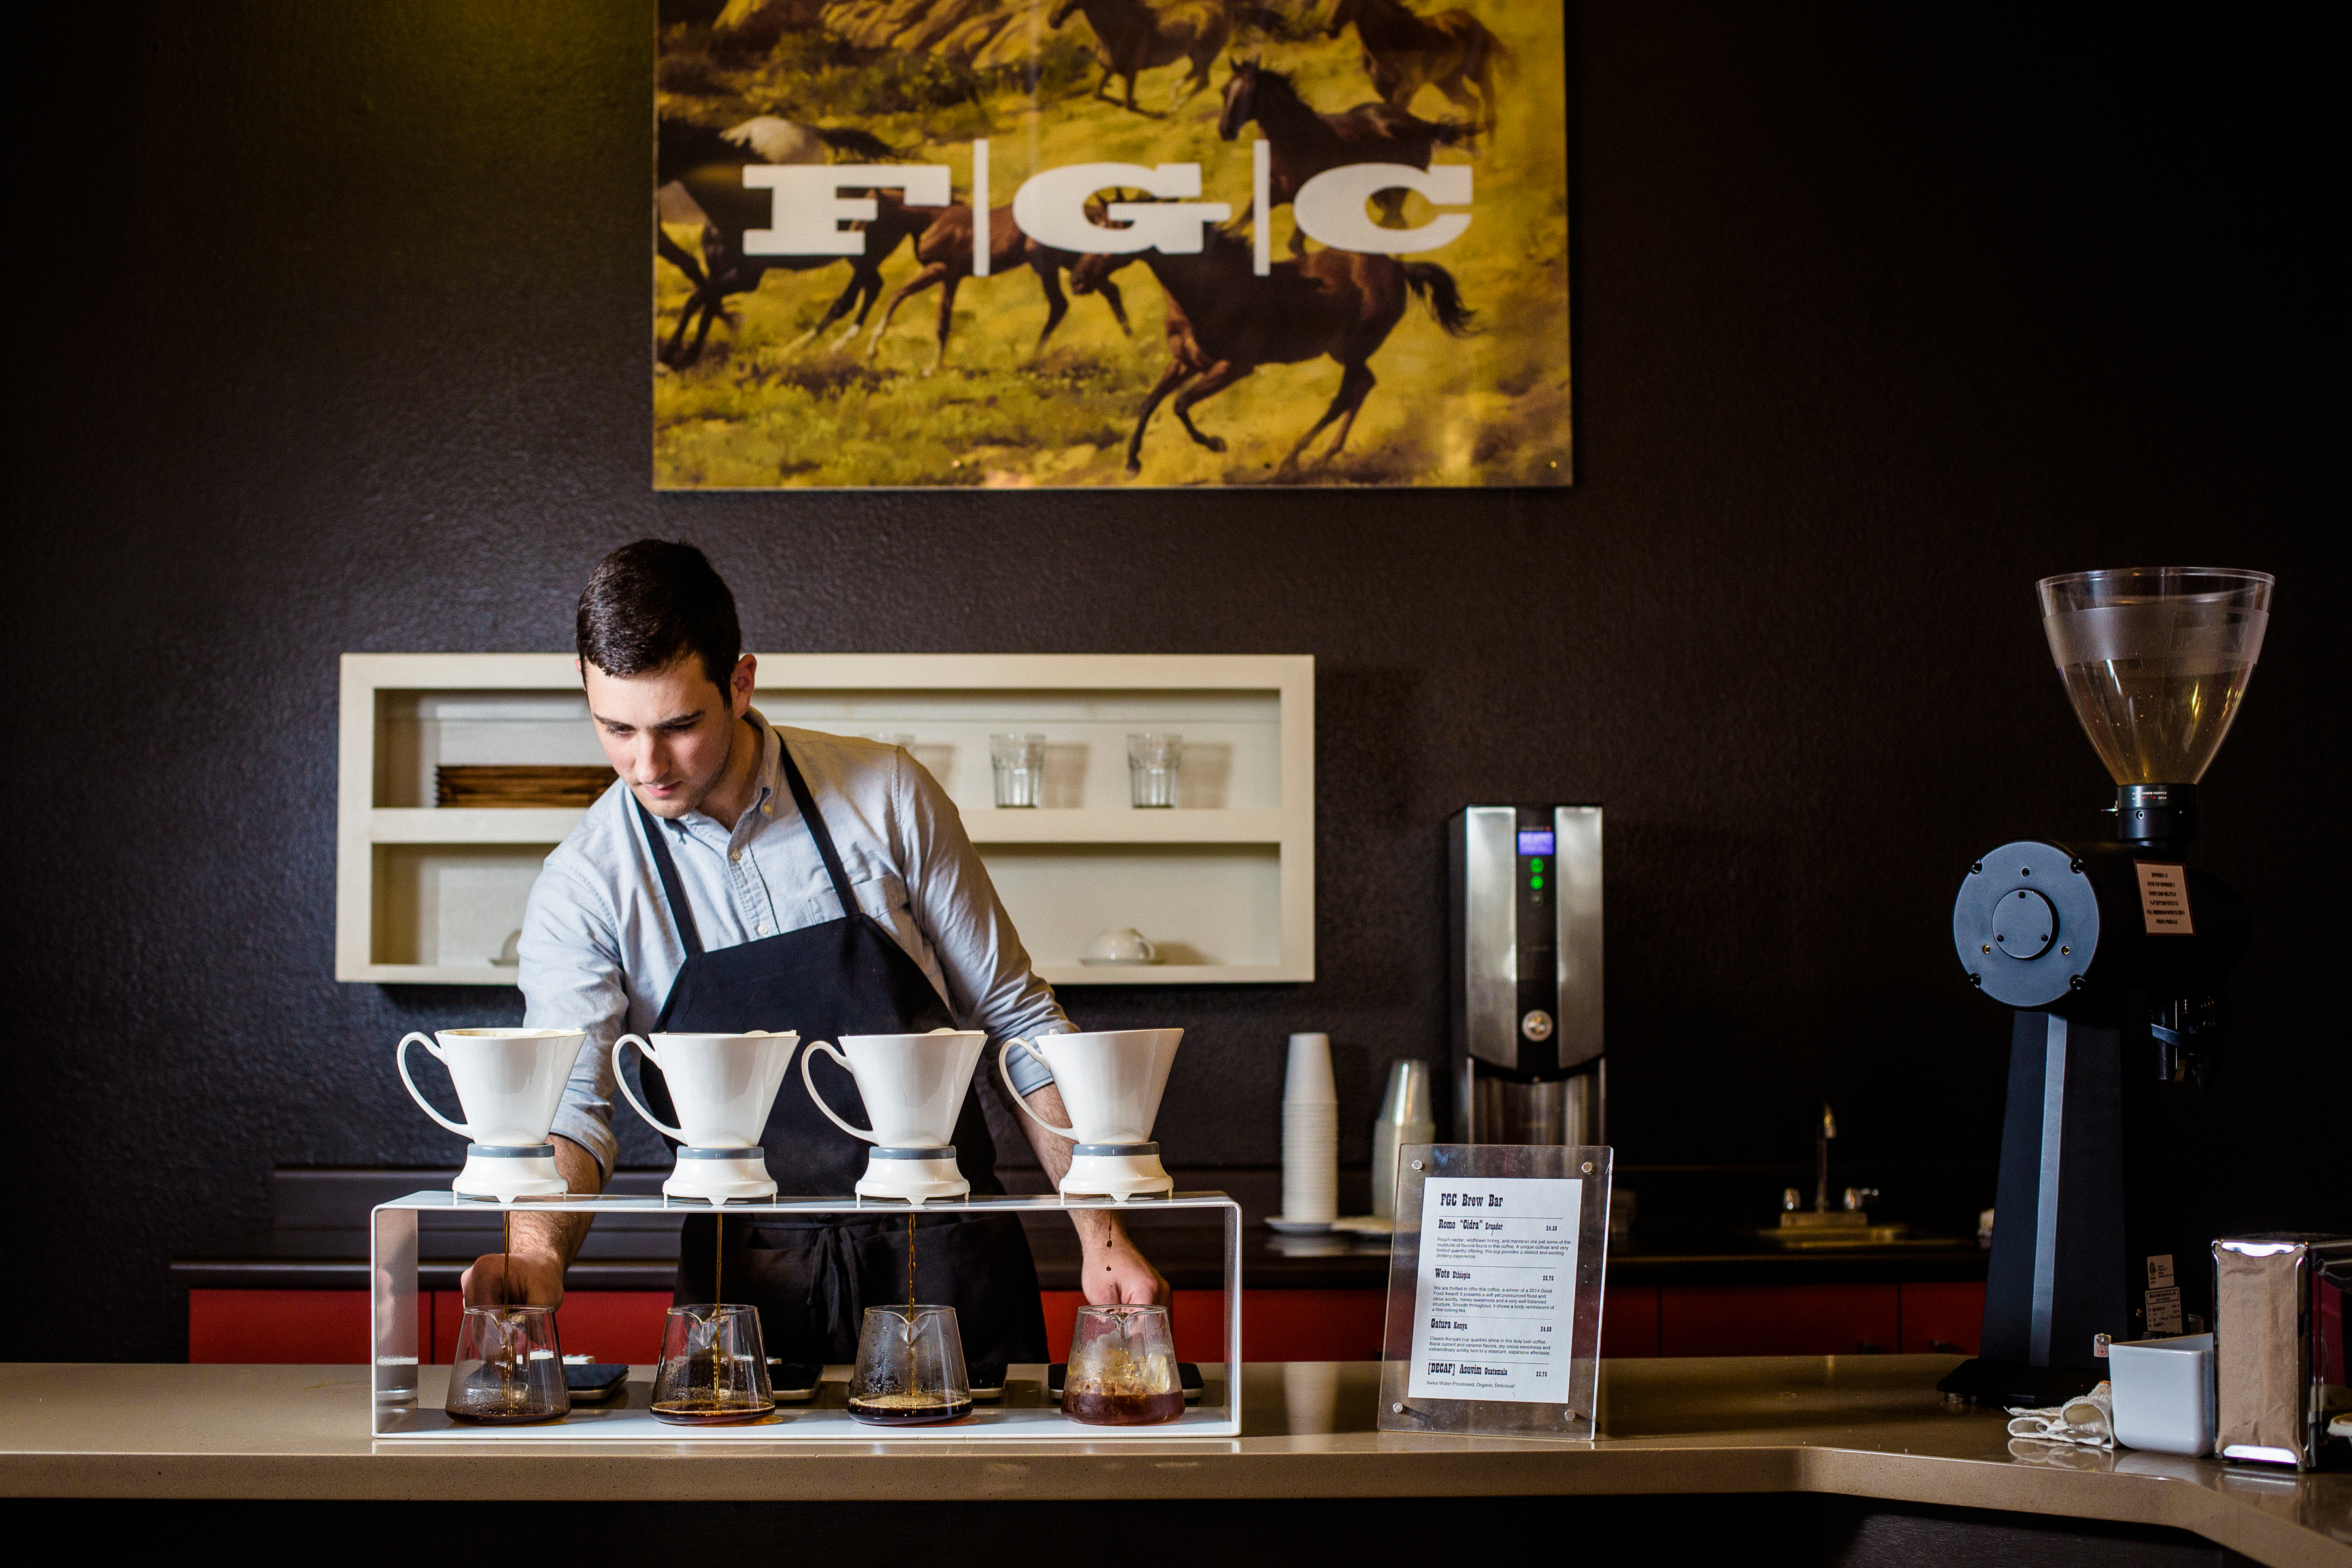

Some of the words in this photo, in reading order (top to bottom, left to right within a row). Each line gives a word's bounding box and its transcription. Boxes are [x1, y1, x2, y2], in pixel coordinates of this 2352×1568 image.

[1441, 1193, 1457, 1206] FGC
[1462, 1194, 1484, 1207] Brew
[1488, 1194, 1503, 1207] Bar
[1439, 1219, 1455, 1229] Romo
[1435, 1268, 1450, 1279] Wote
[1452, 1271, 1471, 1281] Ethiopia
[1431, 1318, 1451, 1329] Gatura
[1454, 1322, 1467, 1331] Kenya
[1428, 1363, 1455, 1376] [DECAF]
[1460, 1364, 1481, 1375] Asuvim
[1484, 1367, 1507, 1376] Guatemala
